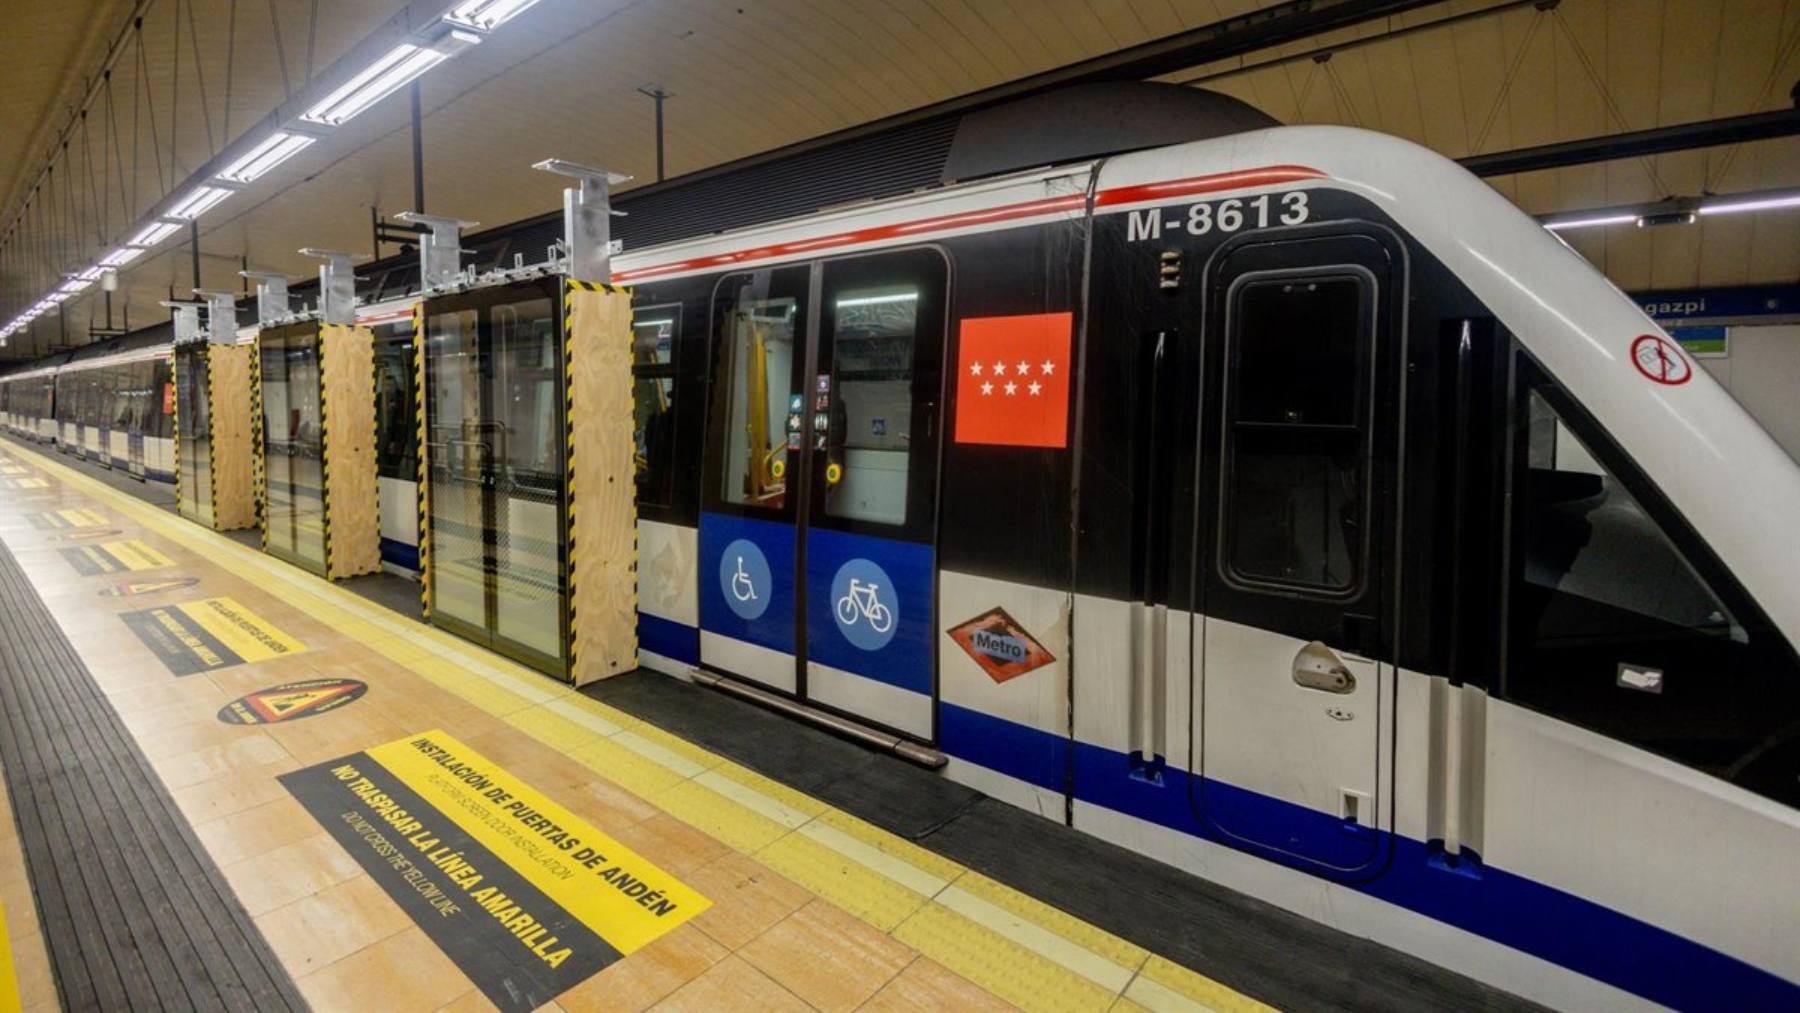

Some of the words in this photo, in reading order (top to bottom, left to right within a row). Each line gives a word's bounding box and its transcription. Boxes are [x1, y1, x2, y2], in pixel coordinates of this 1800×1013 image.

[1128, 191, 1309, 242] M-8613
[1640, 298, 1705, 316] gazpi
[976, 633, 1022, 657] Metro
[410, 738, 493, 791] INSTALACIÓN
[483, 788, 513, 804] DE
[502, 800, 580, 850] PUERTAS
[572, 847, 607, 870] DE
[597, 866, 678, 917] ANDÉN
[331, 764, 360, 780] NO
[347, 777, 423, 835] TRASPASAR
[408, 831, 441, 852] LA
[427, 847, 484, 890] LÍNEA
[470, 886, 573, 969] AMARILLA
[364, 833, 397, 856] CROSS
[387, 853, 412, 870] THE
[400, 865, 443, 898] YELLOW
[429, 894, 461, 917] LINE
